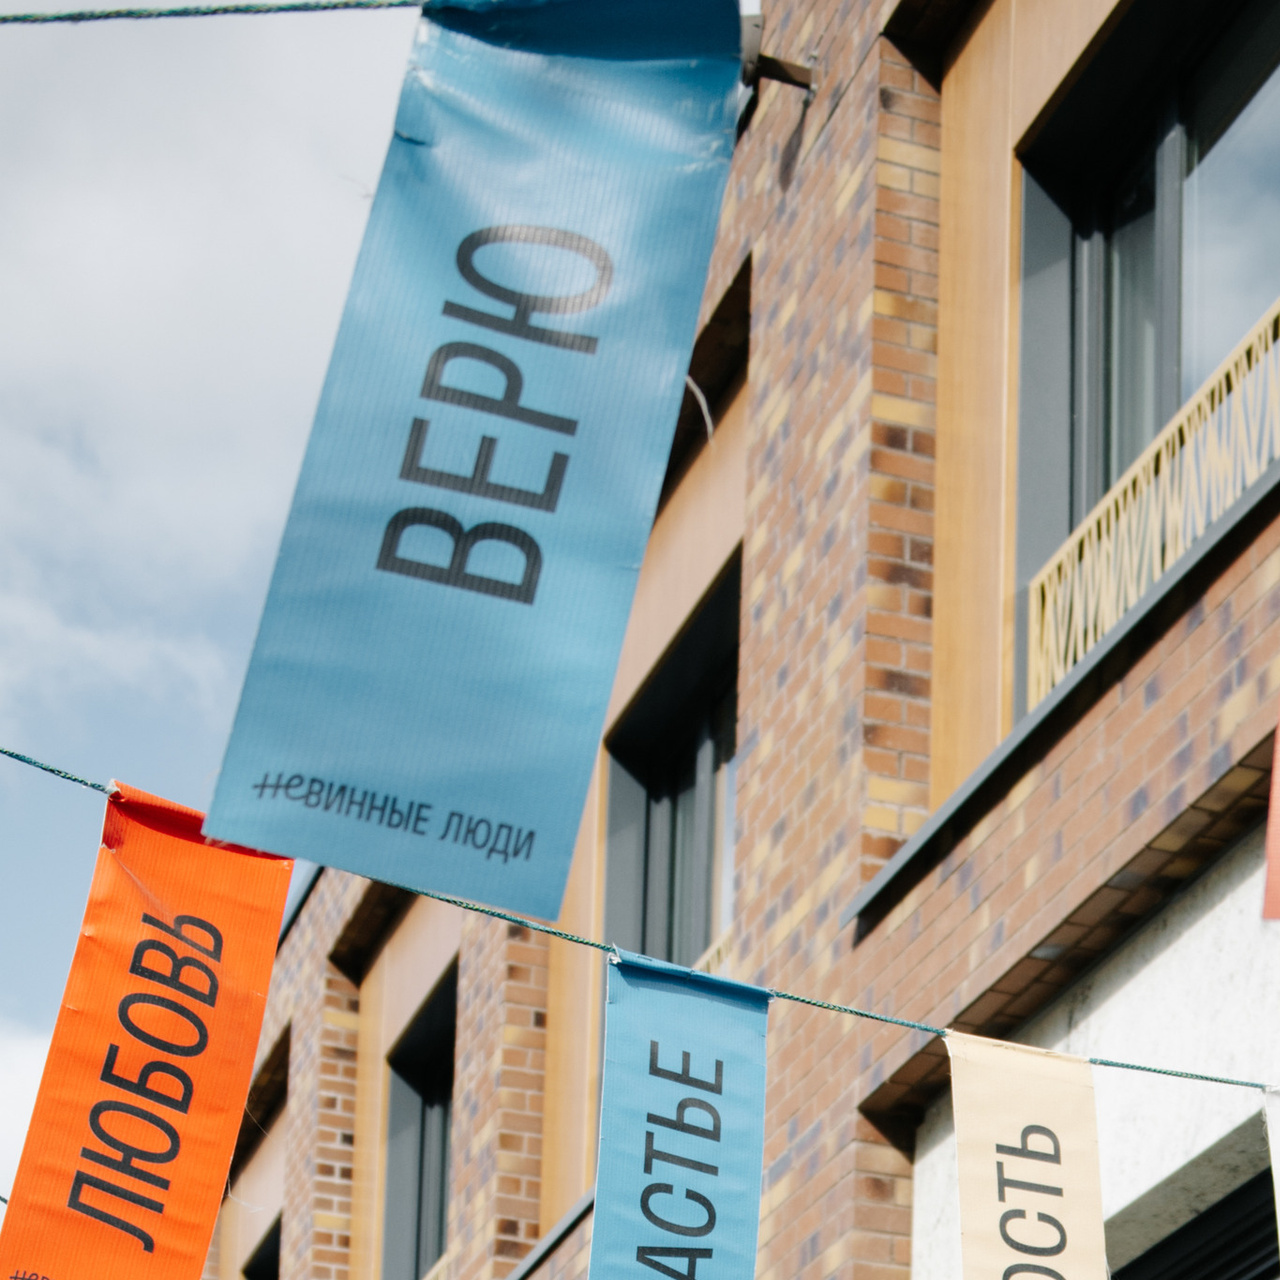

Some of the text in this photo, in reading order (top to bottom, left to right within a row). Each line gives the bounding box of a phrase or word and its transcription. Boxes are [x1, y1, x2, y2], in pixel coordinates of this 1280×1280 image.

[375, 223, 615, 606] ВЕРЮ
[441, 804, 537, 865] ЛЮДИ
[67, 911, 225, 1254] ЛЮБОВЬ
